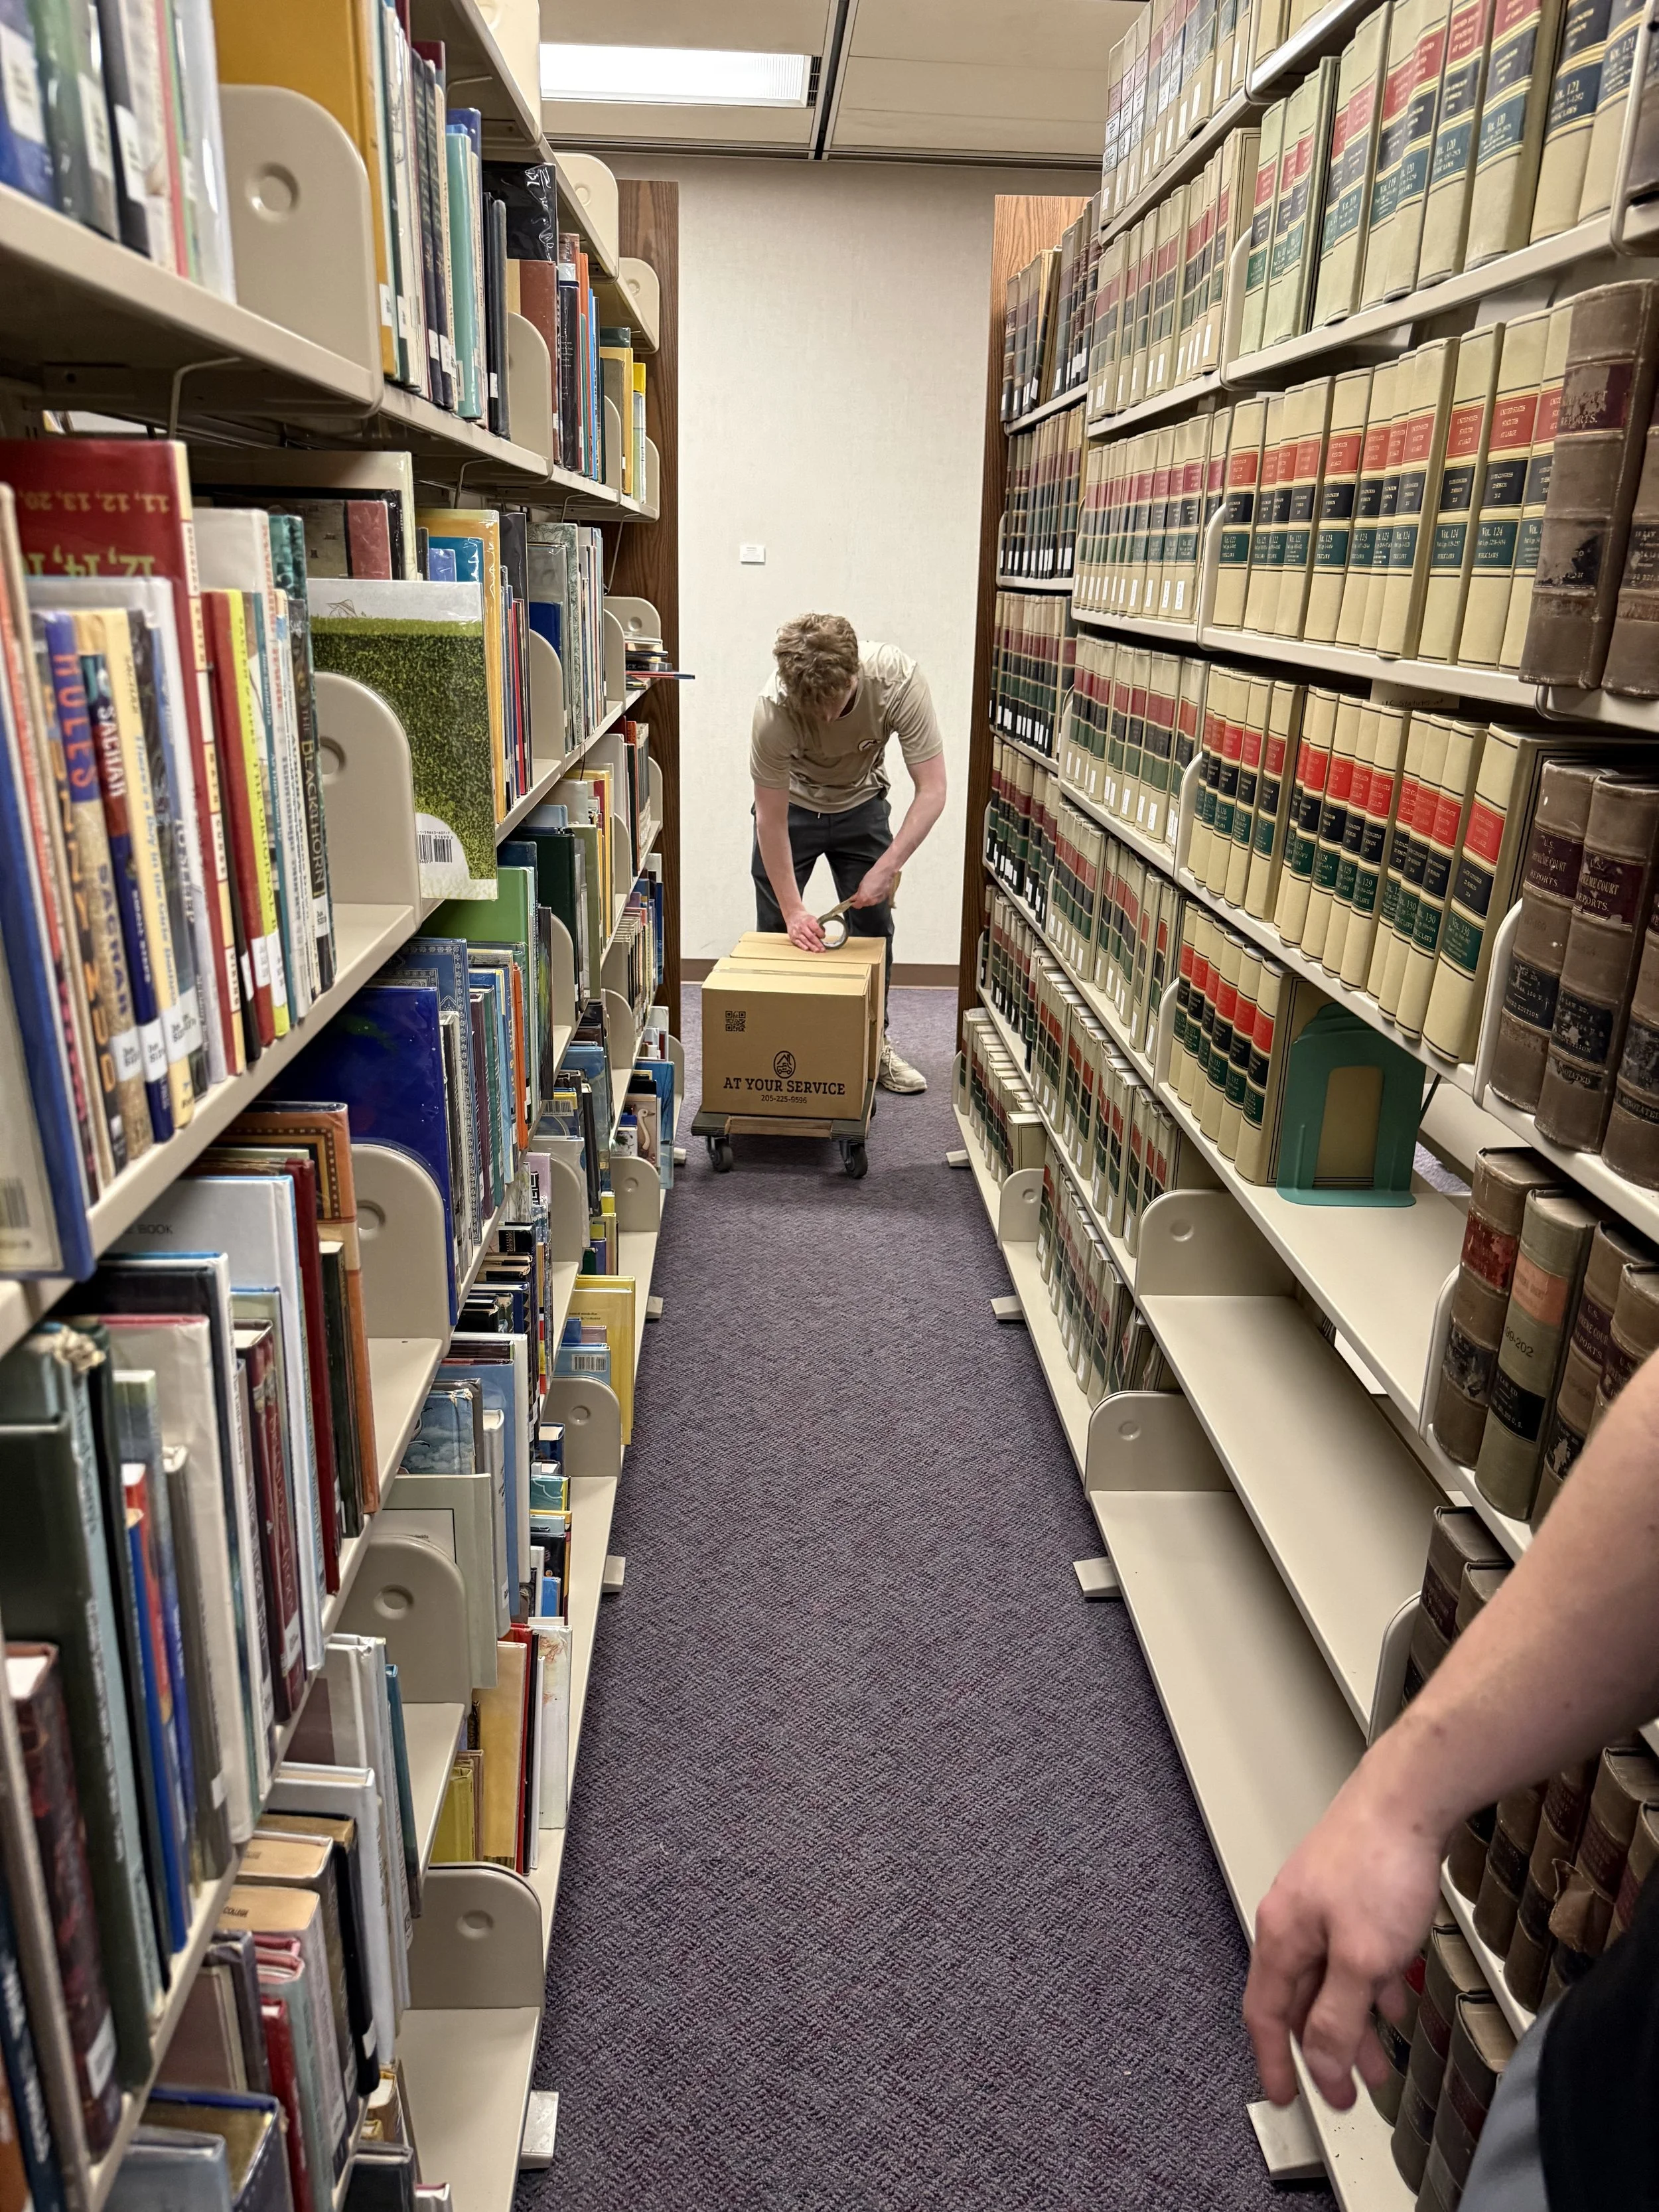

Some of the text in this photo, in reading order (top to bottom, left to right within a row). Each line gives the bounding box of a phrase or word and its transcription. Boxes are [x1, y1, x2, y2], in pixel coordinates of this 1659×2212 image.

[1566, 80, 1580, 95] 121
[1451, 528, 1459, 538] 124
[1492, 525, 1503, 536] 124
[97, 703, 126, 798] SACHAR
[300, 739, 325, 884] BLACKTHORN
[1362, 877, 1373, 888] 129
[1597, 877, 1620, 895] COURT
[1406, 899, 1417, 911] 130
[1425, 913, 1437, 924] 130
[723, 1077, 845, 1095] AT YOUR SERVICE
[761, 1095, 807, 1104] 205-225-9596
[139, 1224, 174, 1234] BOOK
[1592, 1325, 1609, 1347] COUR
